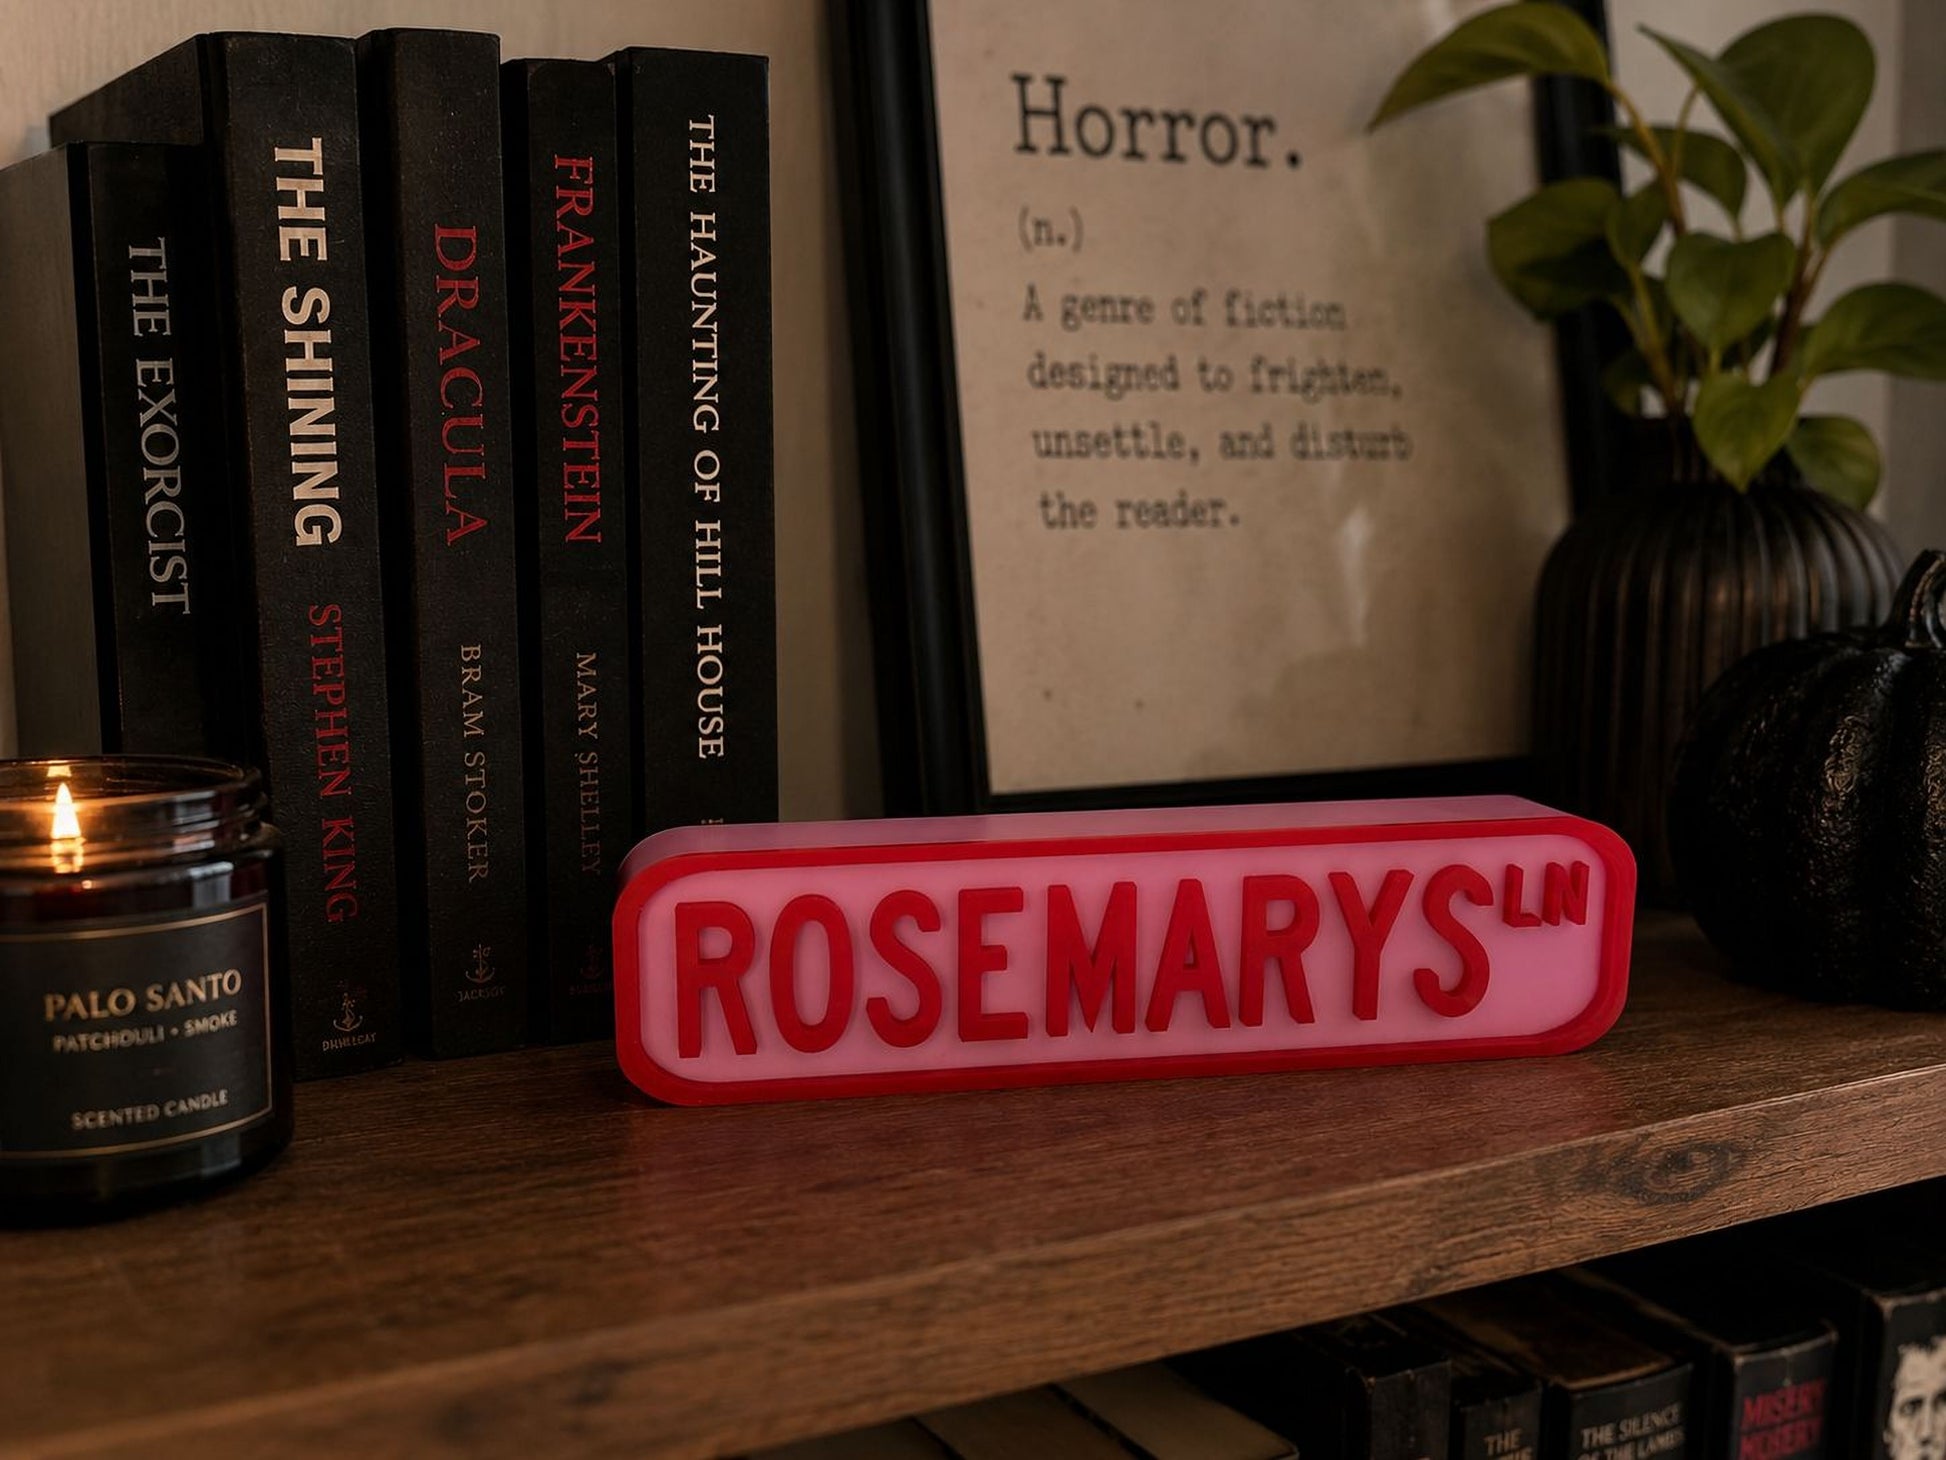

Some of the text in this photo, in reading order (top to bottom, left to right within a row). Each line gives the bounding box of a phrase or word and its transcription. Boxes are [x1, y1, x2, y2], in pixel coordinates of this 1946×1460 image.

[1011, 72, 1302, 168] Horror.
[1019, 206, 1084, 253] (n.)
[274, 137, 343, 547] THE SHINING
[1023, 284, 1347, 331] A genre of fiction
[434, 223, 488, 546] DRACULA
[554, 154, 602, 543] FRANKENSTEIN
[1027, 352, 1402, 402] designed to frighten,
[128, 236, 191, 616] THE EXORCIST
[690, 114, 724, 759] THE HAUNTING OF HILL HOUSE
[1033, 421, 1414, 466] unsettle, and disturb
[1040, 490, 1240, 530] the reader.
[308, 603, 360, 924] STEPHEN KING
[460, 644, 490, 884] BRAM STOKER
[576, 652, 601, 876] MARY SHELLEY
[43, 968, 242, 1022] PALO SANTO
[674, 860, 1588, 1060] ROSEMARYS LN
[53, 1009, 239, 1054] PATCHOULI SMOKE
[70, 1088, 228, 1131] SCENTED CANDLE
[1483, 1428, 1523, 1457] THE
[1581, 1422, 1616, 1450] THE
